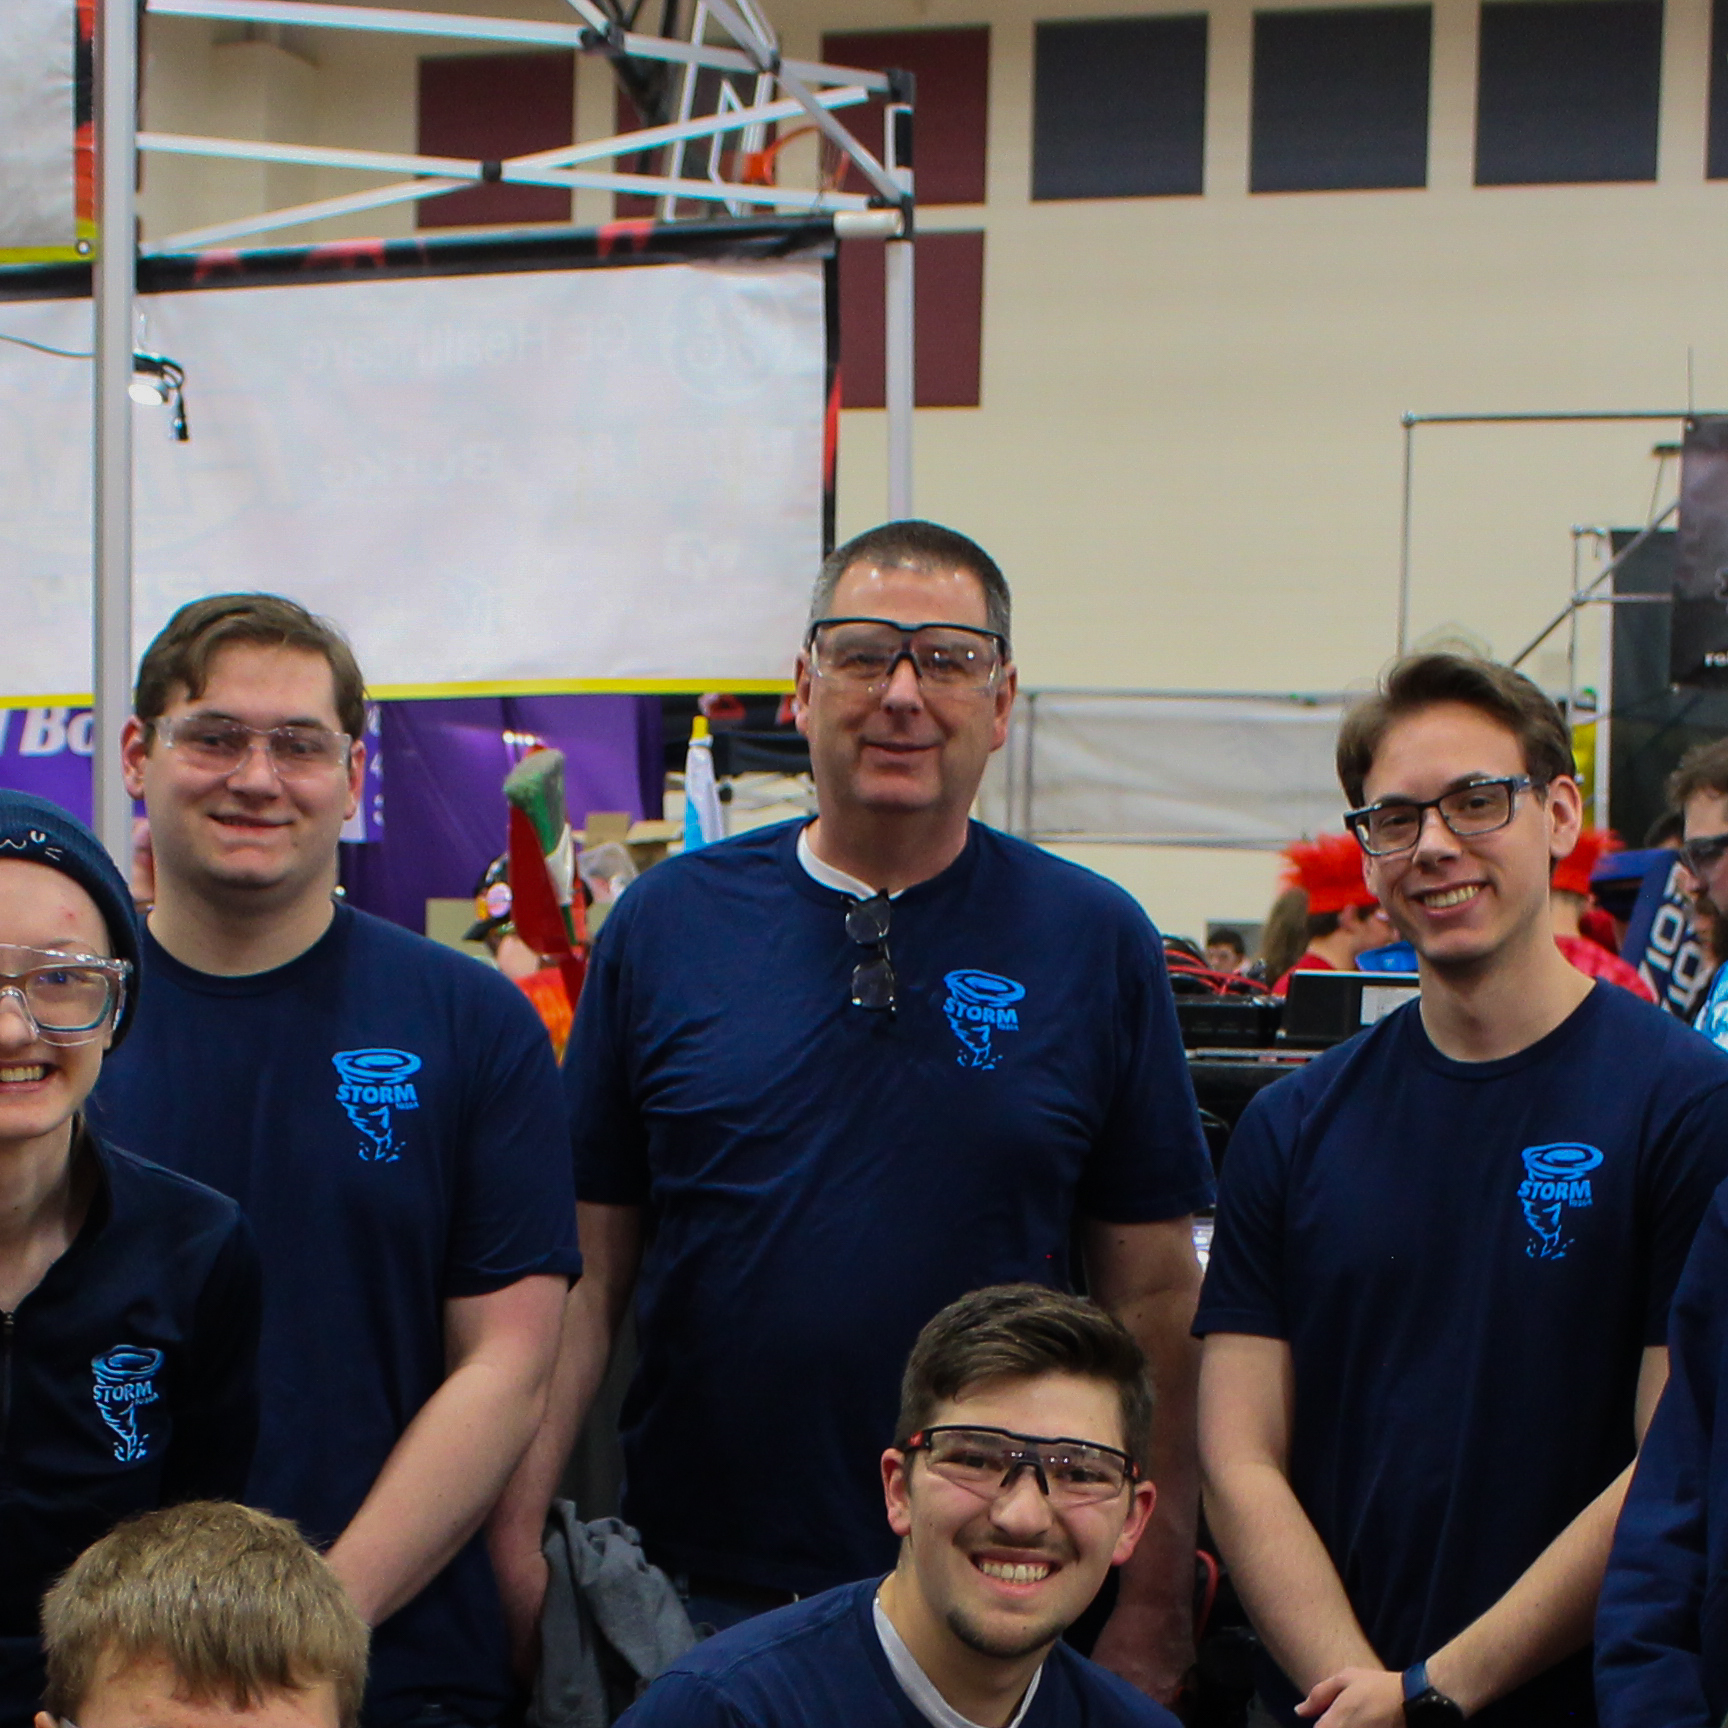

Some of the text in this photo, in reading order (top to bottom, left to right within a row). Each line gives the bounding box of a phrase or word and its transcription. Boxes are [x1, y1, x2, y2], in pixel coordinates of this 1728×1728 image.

[943, 996, 1019, 1025] STORM
[335, 1083, 418, 1105] STORM
[1516, 1179, 1592, 1201] STORM
[92, 1380, 152, 1403] STORM
